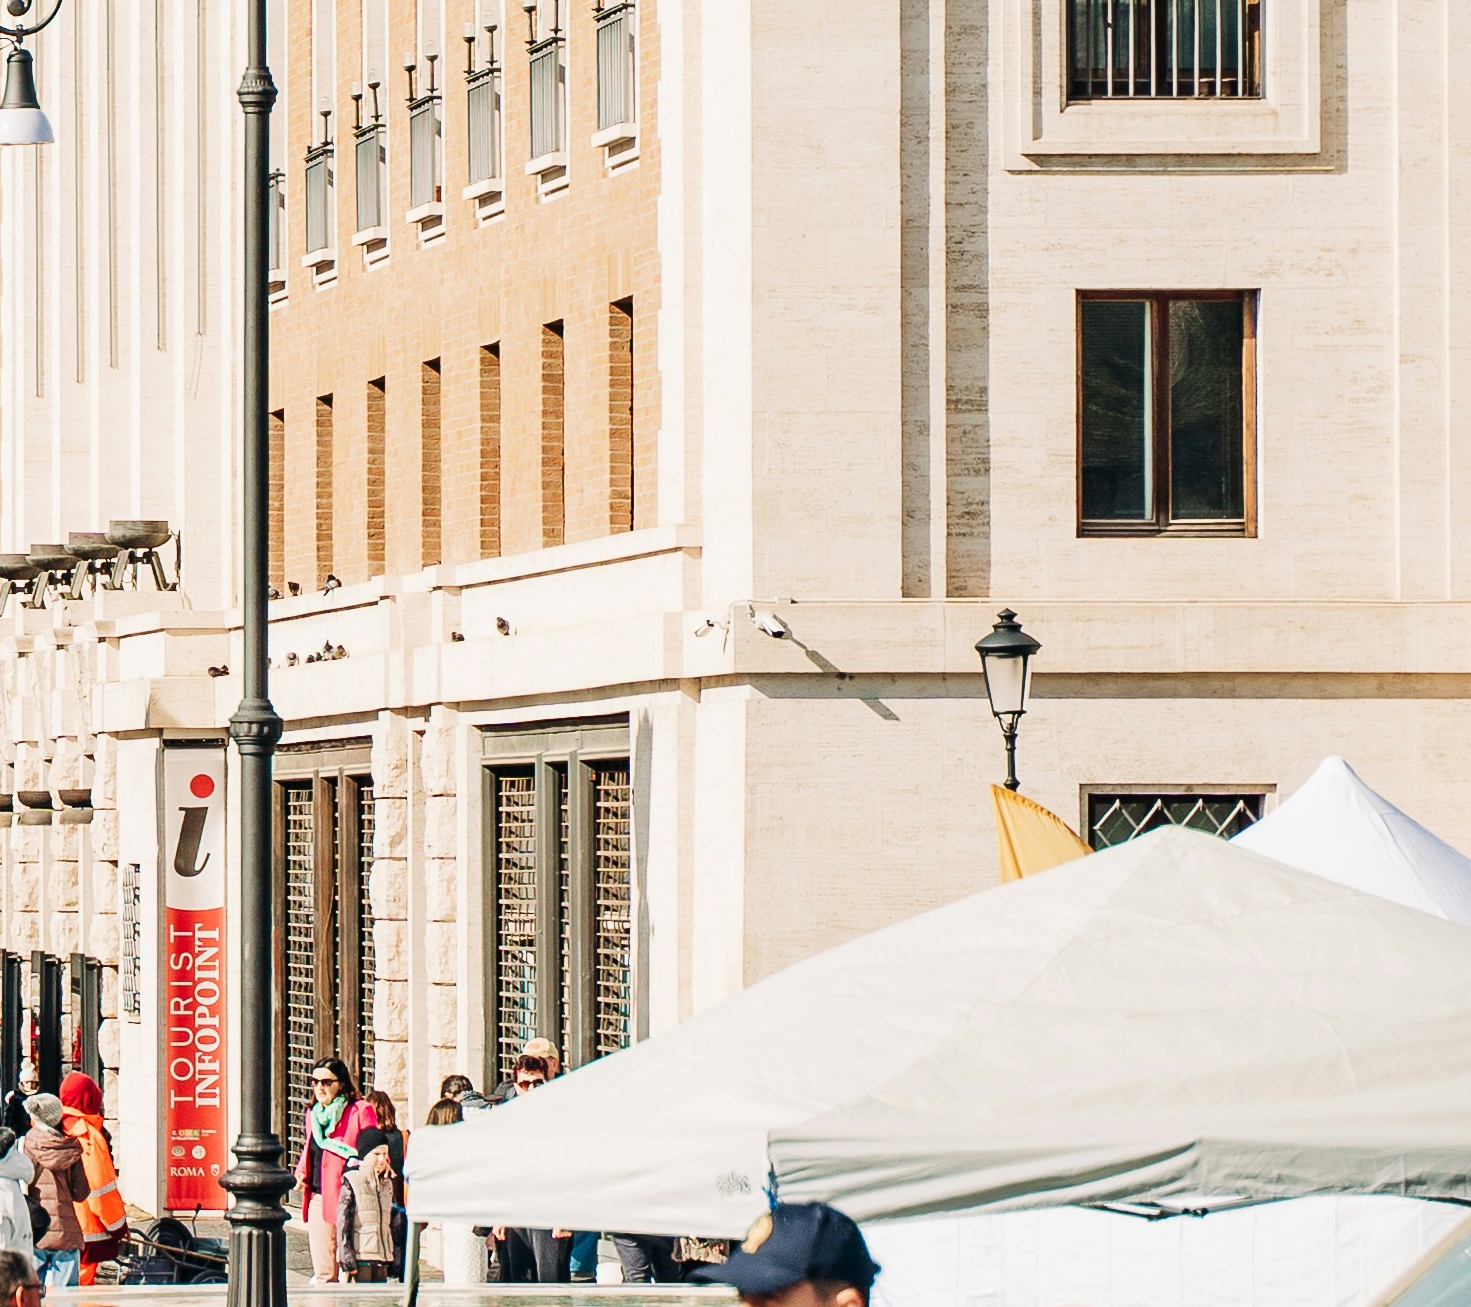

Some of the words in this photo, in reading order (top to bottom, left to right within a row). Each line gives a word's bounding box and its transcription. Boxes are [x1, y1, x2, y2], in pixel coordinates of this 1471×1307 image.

[169, 924, 194, 1109] TOURIST
[194, 923, 221, 1109] INFOPOINT
[170, 1166, 205, 1177] ROMA
